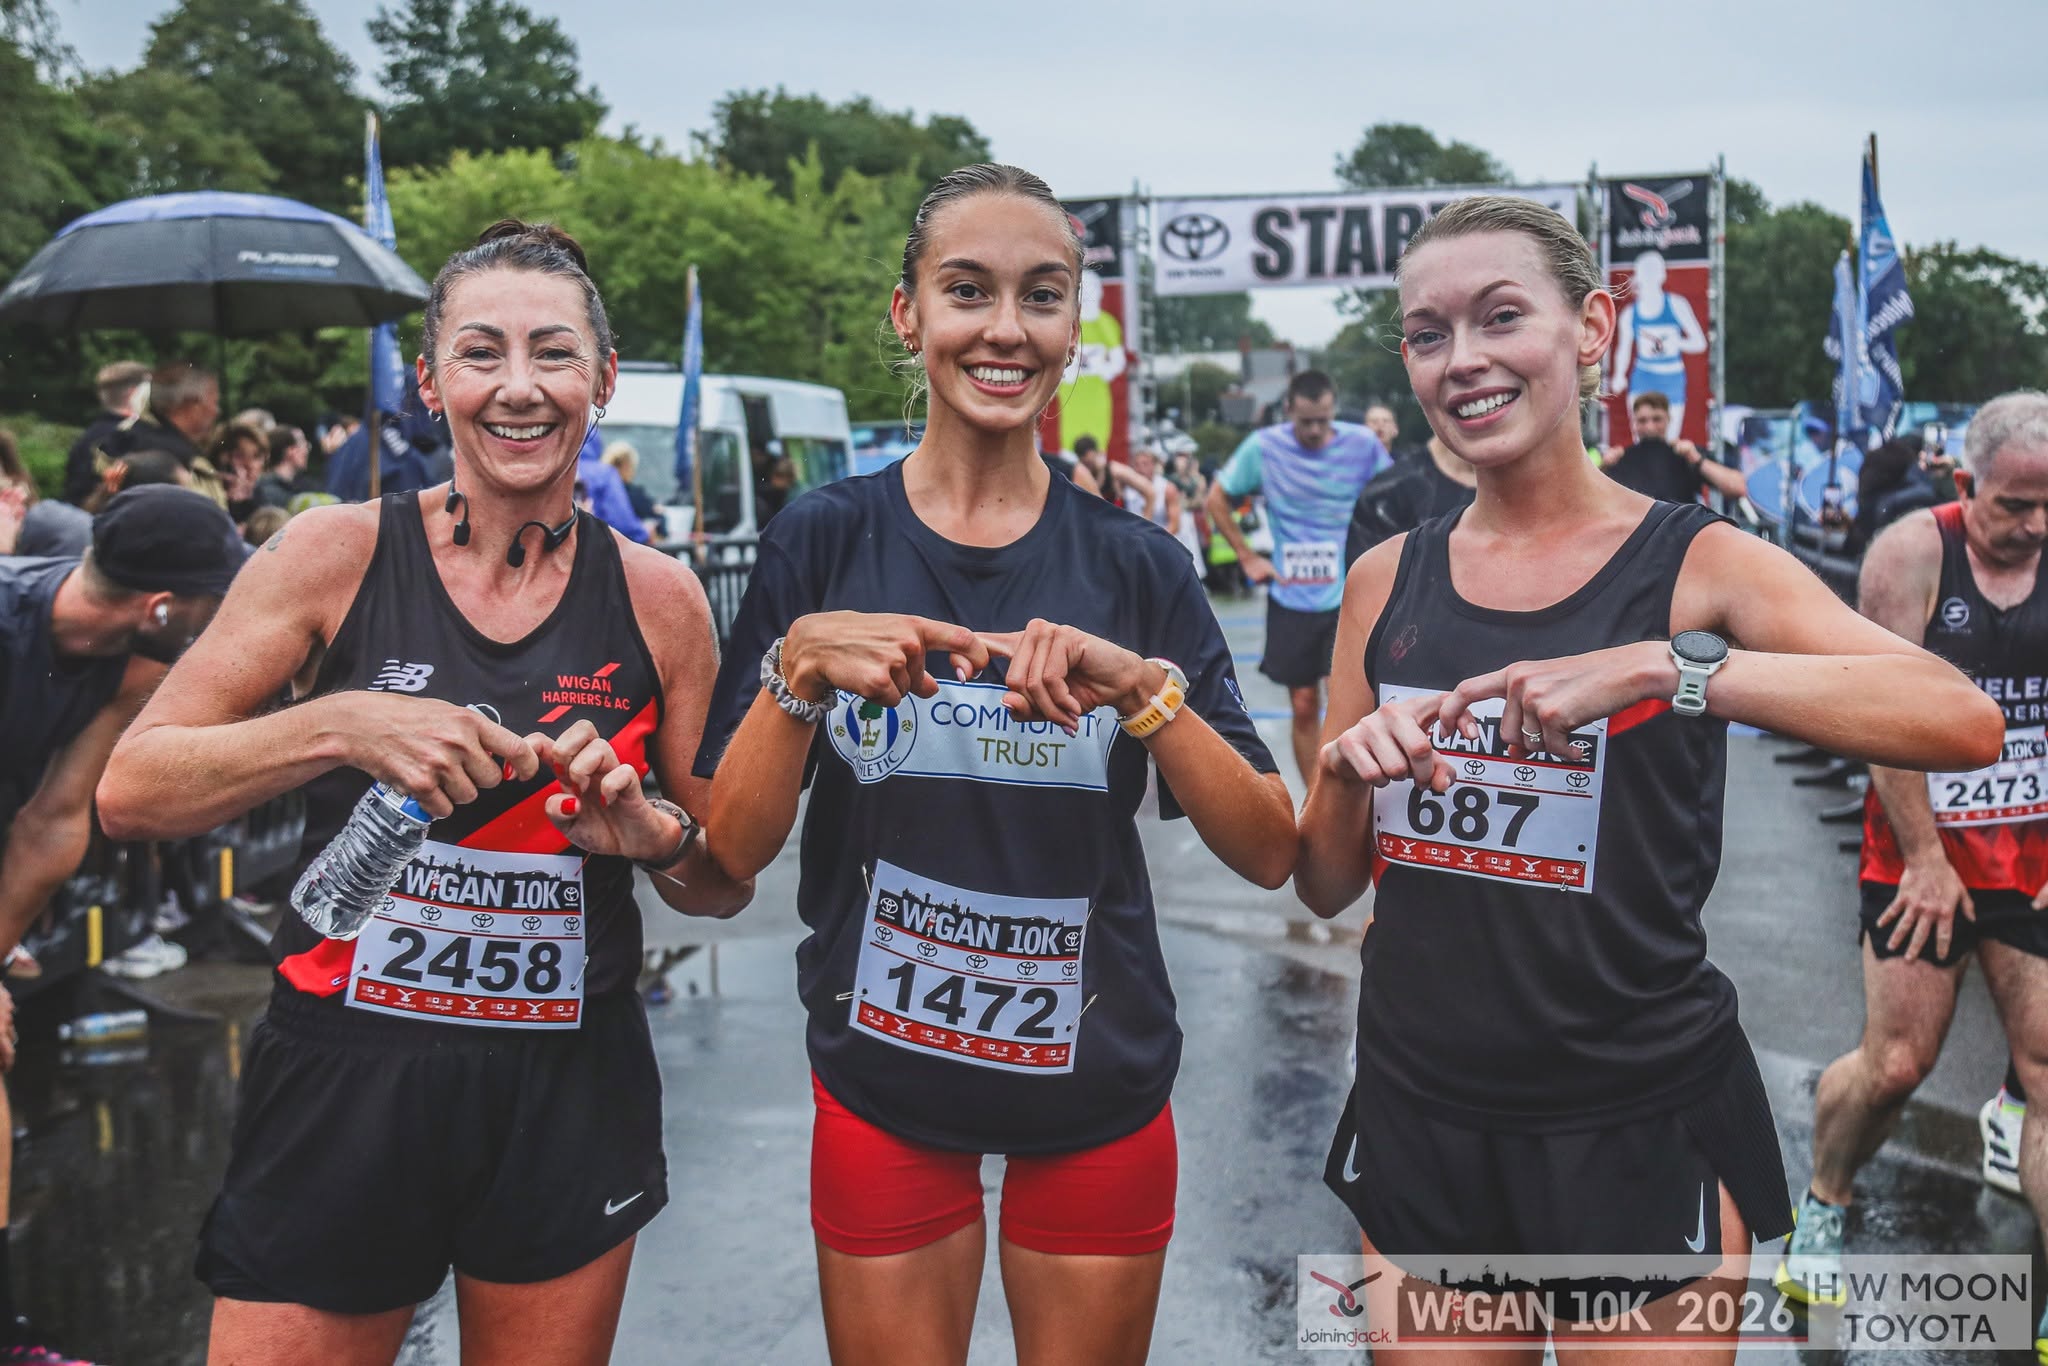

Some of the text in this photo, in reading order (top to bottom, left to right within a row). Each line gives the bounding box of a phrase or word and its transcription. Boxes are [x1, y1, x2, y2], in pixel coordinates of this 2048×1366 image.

[1253, 202, 1446, 282] STAR
[557, 674, 612, 692] WIGAN
[542, 691, 631, 711] HARRIERS & AC
[930, 701, 1102, 738] COMMUTY
[977, 737, 1067, 768] TRUST
[2007, 741, 2035, 760] 10K
[1946, 774, 2041, 808] 2473
[1406, 785, 1540, 848] 687
[511, 880, 561, 910] 10K
[1007, 925, 1062, 956] 10K
[381, 927, 562, 994] 2458
[887, 960, 1059, 1039] 1472
